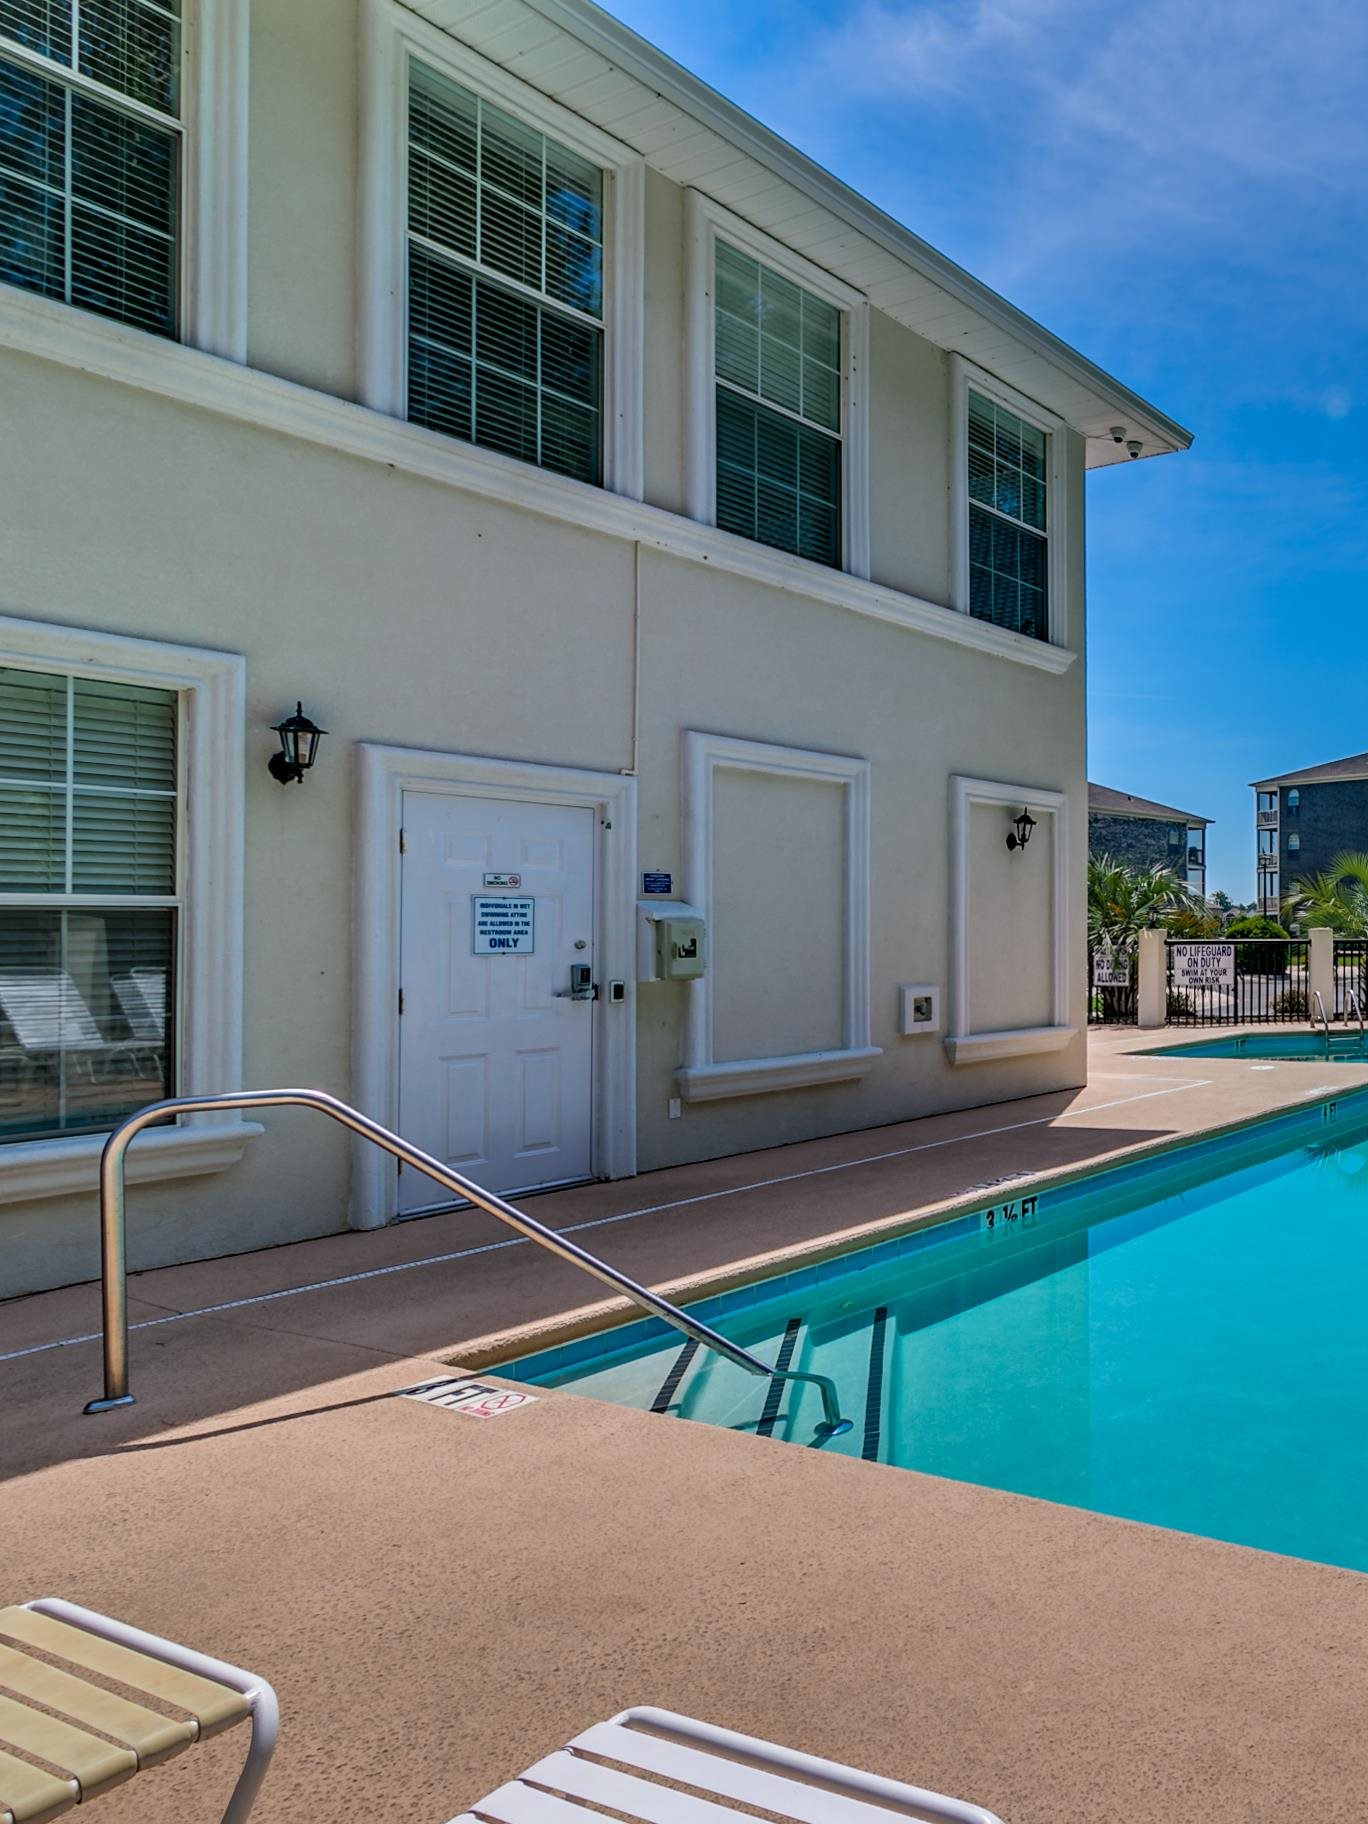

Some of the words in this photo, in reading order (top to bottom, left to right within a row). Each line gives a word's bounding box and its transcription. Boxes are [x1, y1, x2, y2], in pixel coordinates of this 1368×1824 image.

[489, 938, 519, 948] ONLY
[1176, 945, 1188, 957] NO
[1189, 945, 1232, 957] LIFEGUARD
[1187, 957, 1199, 968] ON
[1200, 957, 1221, 968] DUTY
[1181, 969, 1199, 977] SWIM
[1200, 969, 1208, 977] AT
[1210, 969, 1228, 977] YOUR
[1188, 976, 1204, 984] OWN
[1205, 976, 1220, 984] RISK
[1021, 1196, 1038, 1218] FT
[427, 1384, 499, 1406] FT
